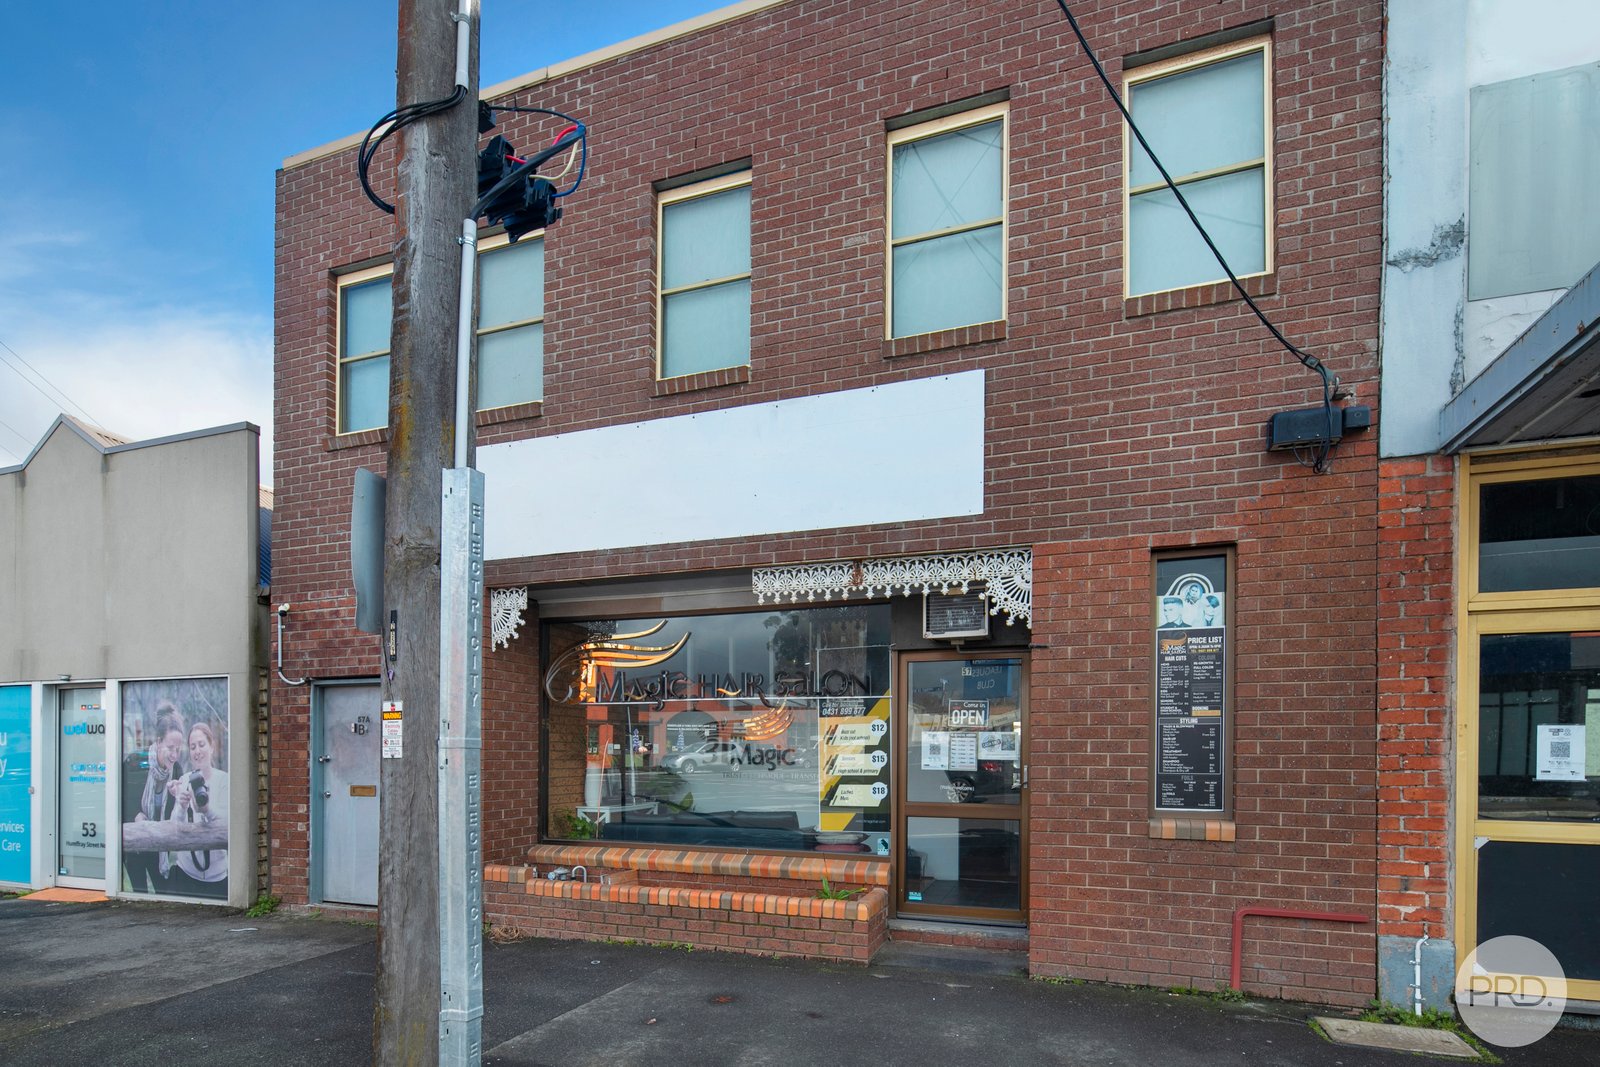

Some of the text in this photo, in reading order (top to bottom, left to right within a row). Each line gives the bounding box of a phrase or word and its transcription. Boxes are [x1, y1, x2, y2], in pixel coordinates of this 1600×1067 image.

[470, 503, 481, 707] ELECTRICITY
[698, 672, 771, 708] HAIR
[822, 708, 839, 716] 0431
[952, 709, 985, 726] OPEN
[871, 724, 885, 732] $12
[730, 743, 796, 771] Magic
[871, 755, 885, 763] $15
[872, 787, 886, 795] $18
[82, 823, 97, 837] 53
[1, 839, 21, 852] Care
[468, 773, 480, 978] ELECTRICITY
